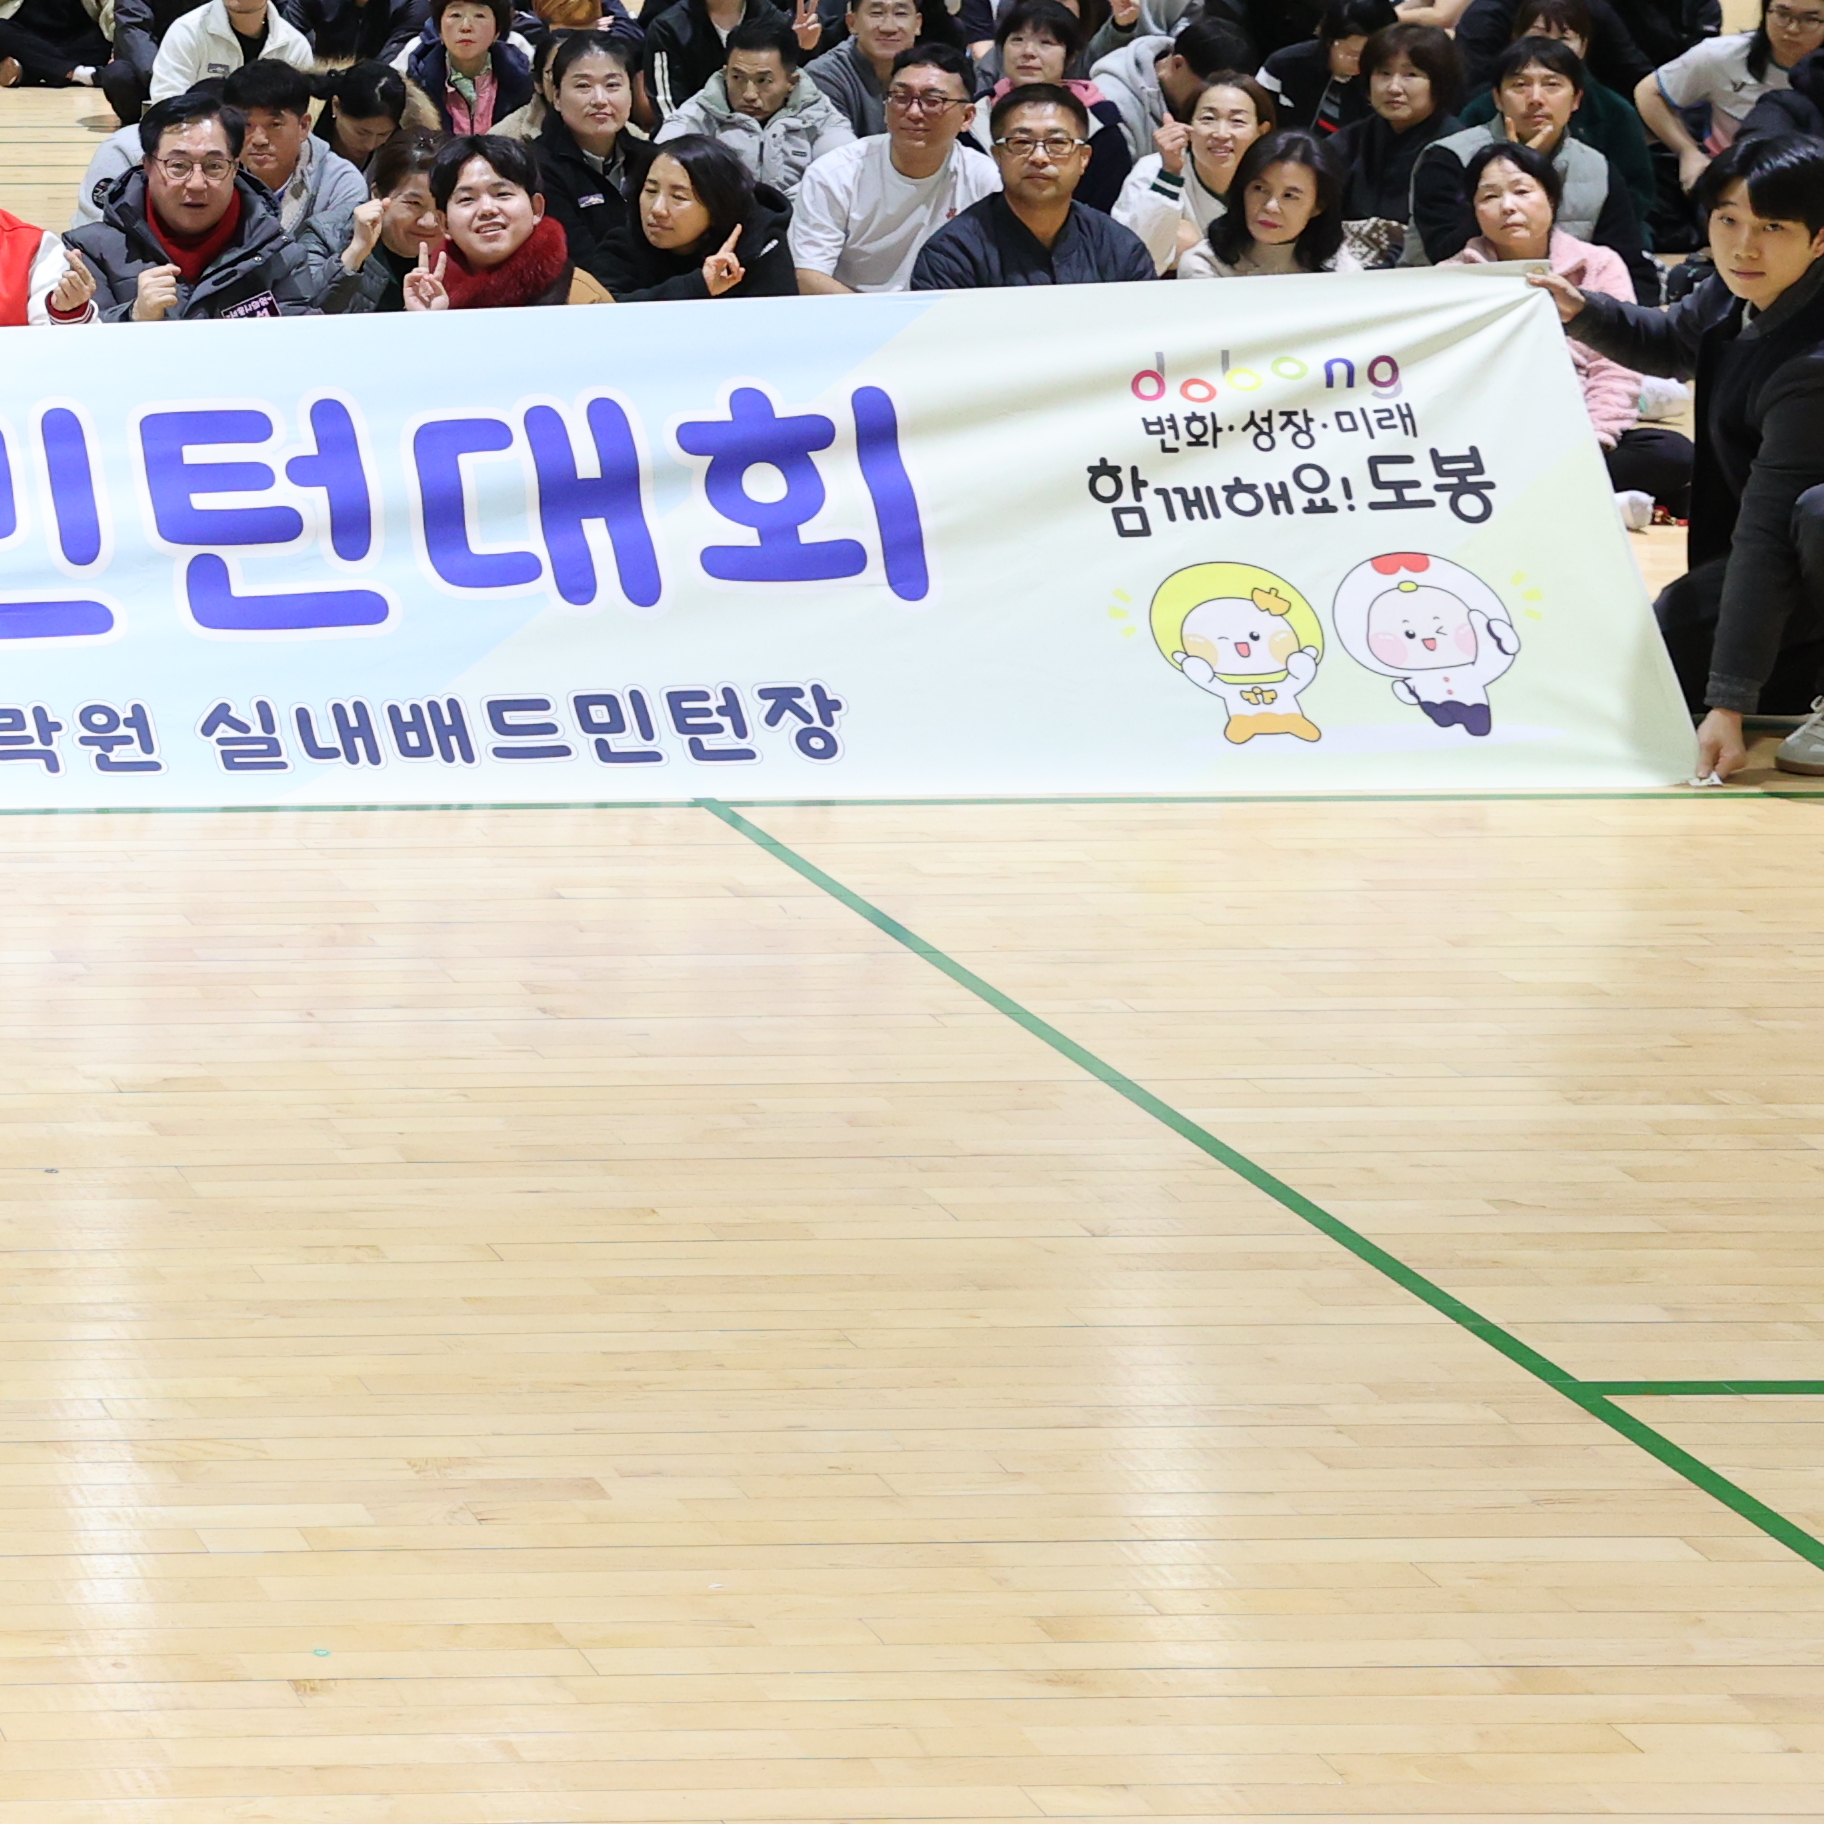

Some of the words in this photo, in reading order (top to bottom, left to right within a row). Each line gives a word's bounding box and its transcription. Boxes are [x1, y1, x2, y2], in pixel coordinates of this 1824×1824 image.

[1131, 349, 1404, 399] dobong
[1087, 457, 1356, 538] 함께해요!
[1366, 445, 1497, 524] 도봉
[201, 683, 843, 771] 실내배드민턴장
